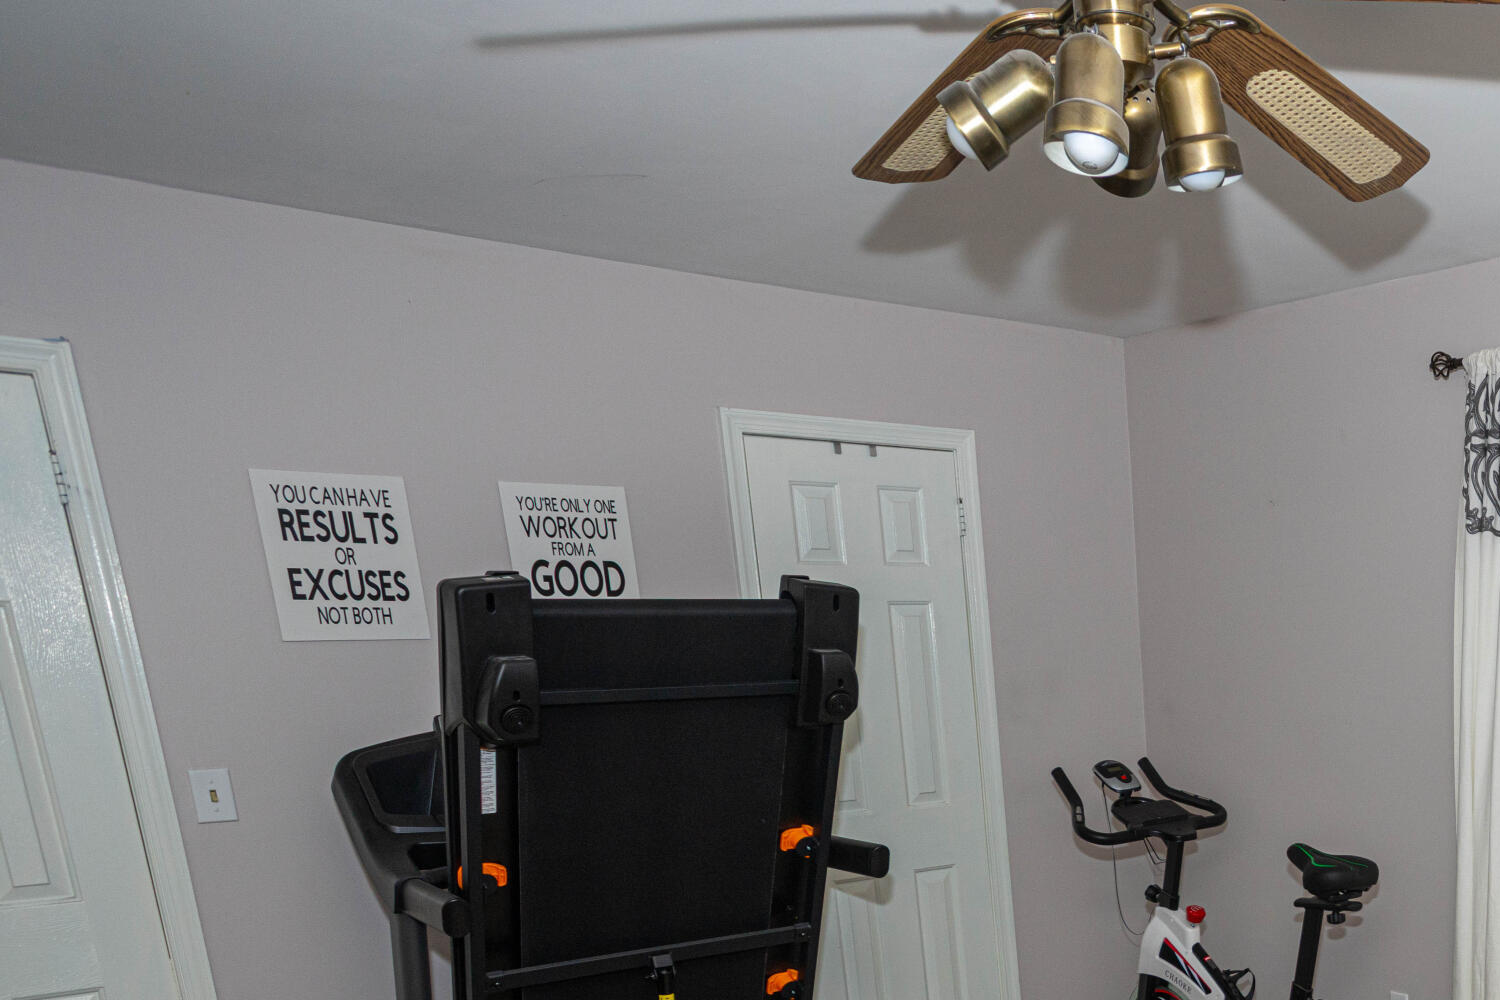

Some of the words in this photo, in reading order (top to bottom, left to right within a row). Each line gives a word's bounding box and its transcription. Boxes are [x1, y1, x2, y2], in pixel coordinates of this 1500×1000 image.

[269, 483, 307, 505] YOU
[308, 486, 345, 507] CAN
[347, 487, 392, 508] HAVE
[515, 495, 558, 513] YOU'RE
[560, 497, 591, 514] ONLY
[593, 499, 616, 514] ONE
[277, 508, 399, 545] RESULTS
[519, 515, 618, 540] WORKOUT
[334, 547, 357, 566] OR
[551, 541, 583, 557] FROM
[585, 543, 596, 557] A
[287, 567, 410, 602] EXCUSES
[531, 560, 626, 598] GOOD
[318, 606, 348, 625] NOT
[352, 607, 393, 625] BOTH
